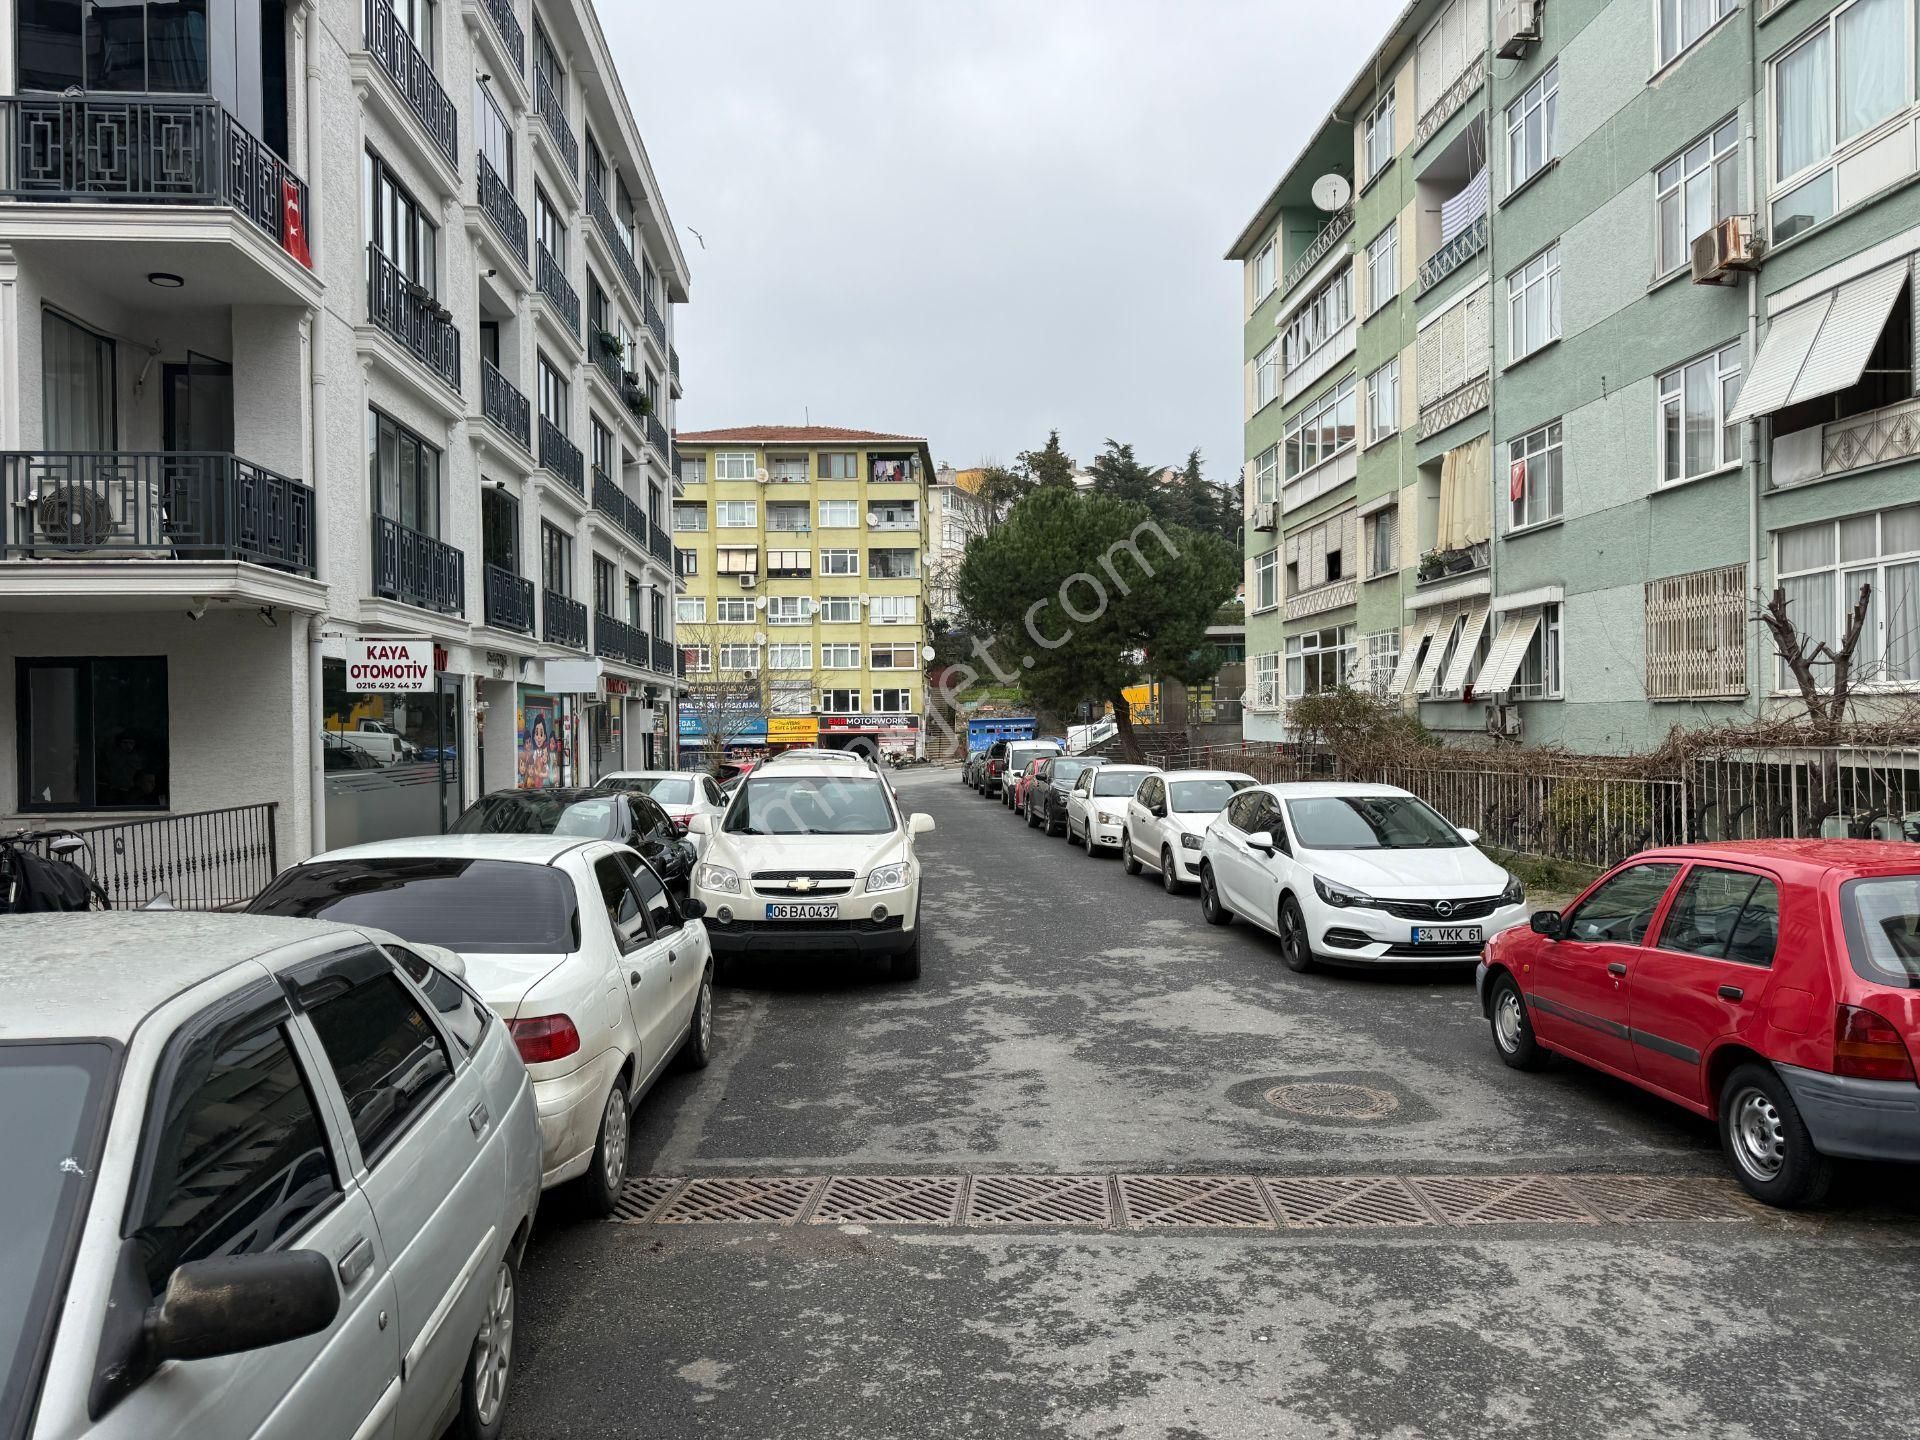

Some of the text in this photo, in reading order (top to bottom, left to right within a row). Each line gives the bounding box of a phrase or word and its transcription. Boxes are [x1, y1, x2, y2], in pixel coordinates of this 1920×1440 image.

[367, 646, 409, 660] KAYA
[350, 660, 428, 679] OTOMOTİV
[356, 682, 423, 690] 0216 492 44 37
[1419, 928, 1481, 941] 34 VKK 61
